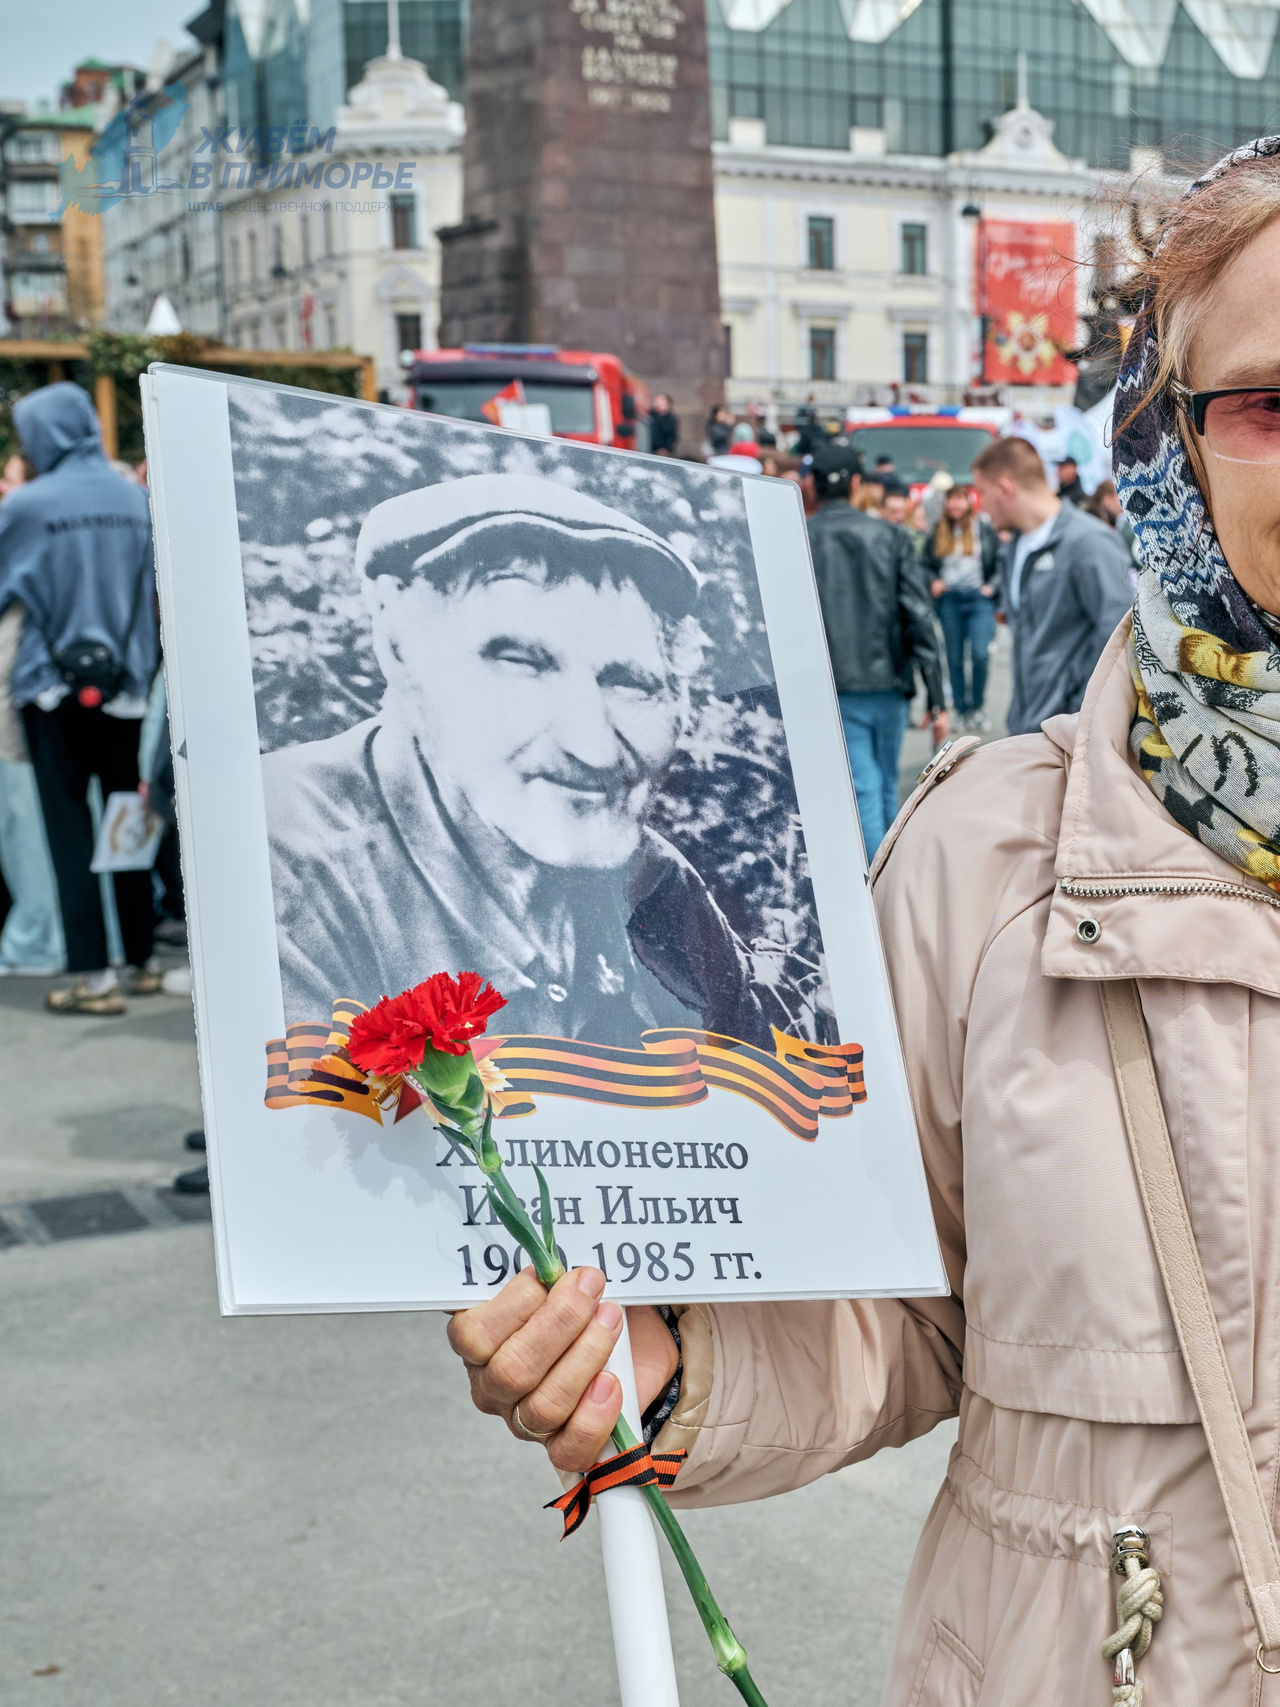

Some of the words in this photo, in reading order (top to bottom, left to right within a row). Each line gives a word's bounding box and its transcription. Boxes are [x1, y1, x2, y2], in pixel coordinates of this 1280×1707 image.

[433, 1126, 749, 1170] Хлимоненко
[459, 1185, 585, 1226] Иан
[595, 1185, 743, 1225] Ильич
[709, 1252, 763, 1280] гг.
